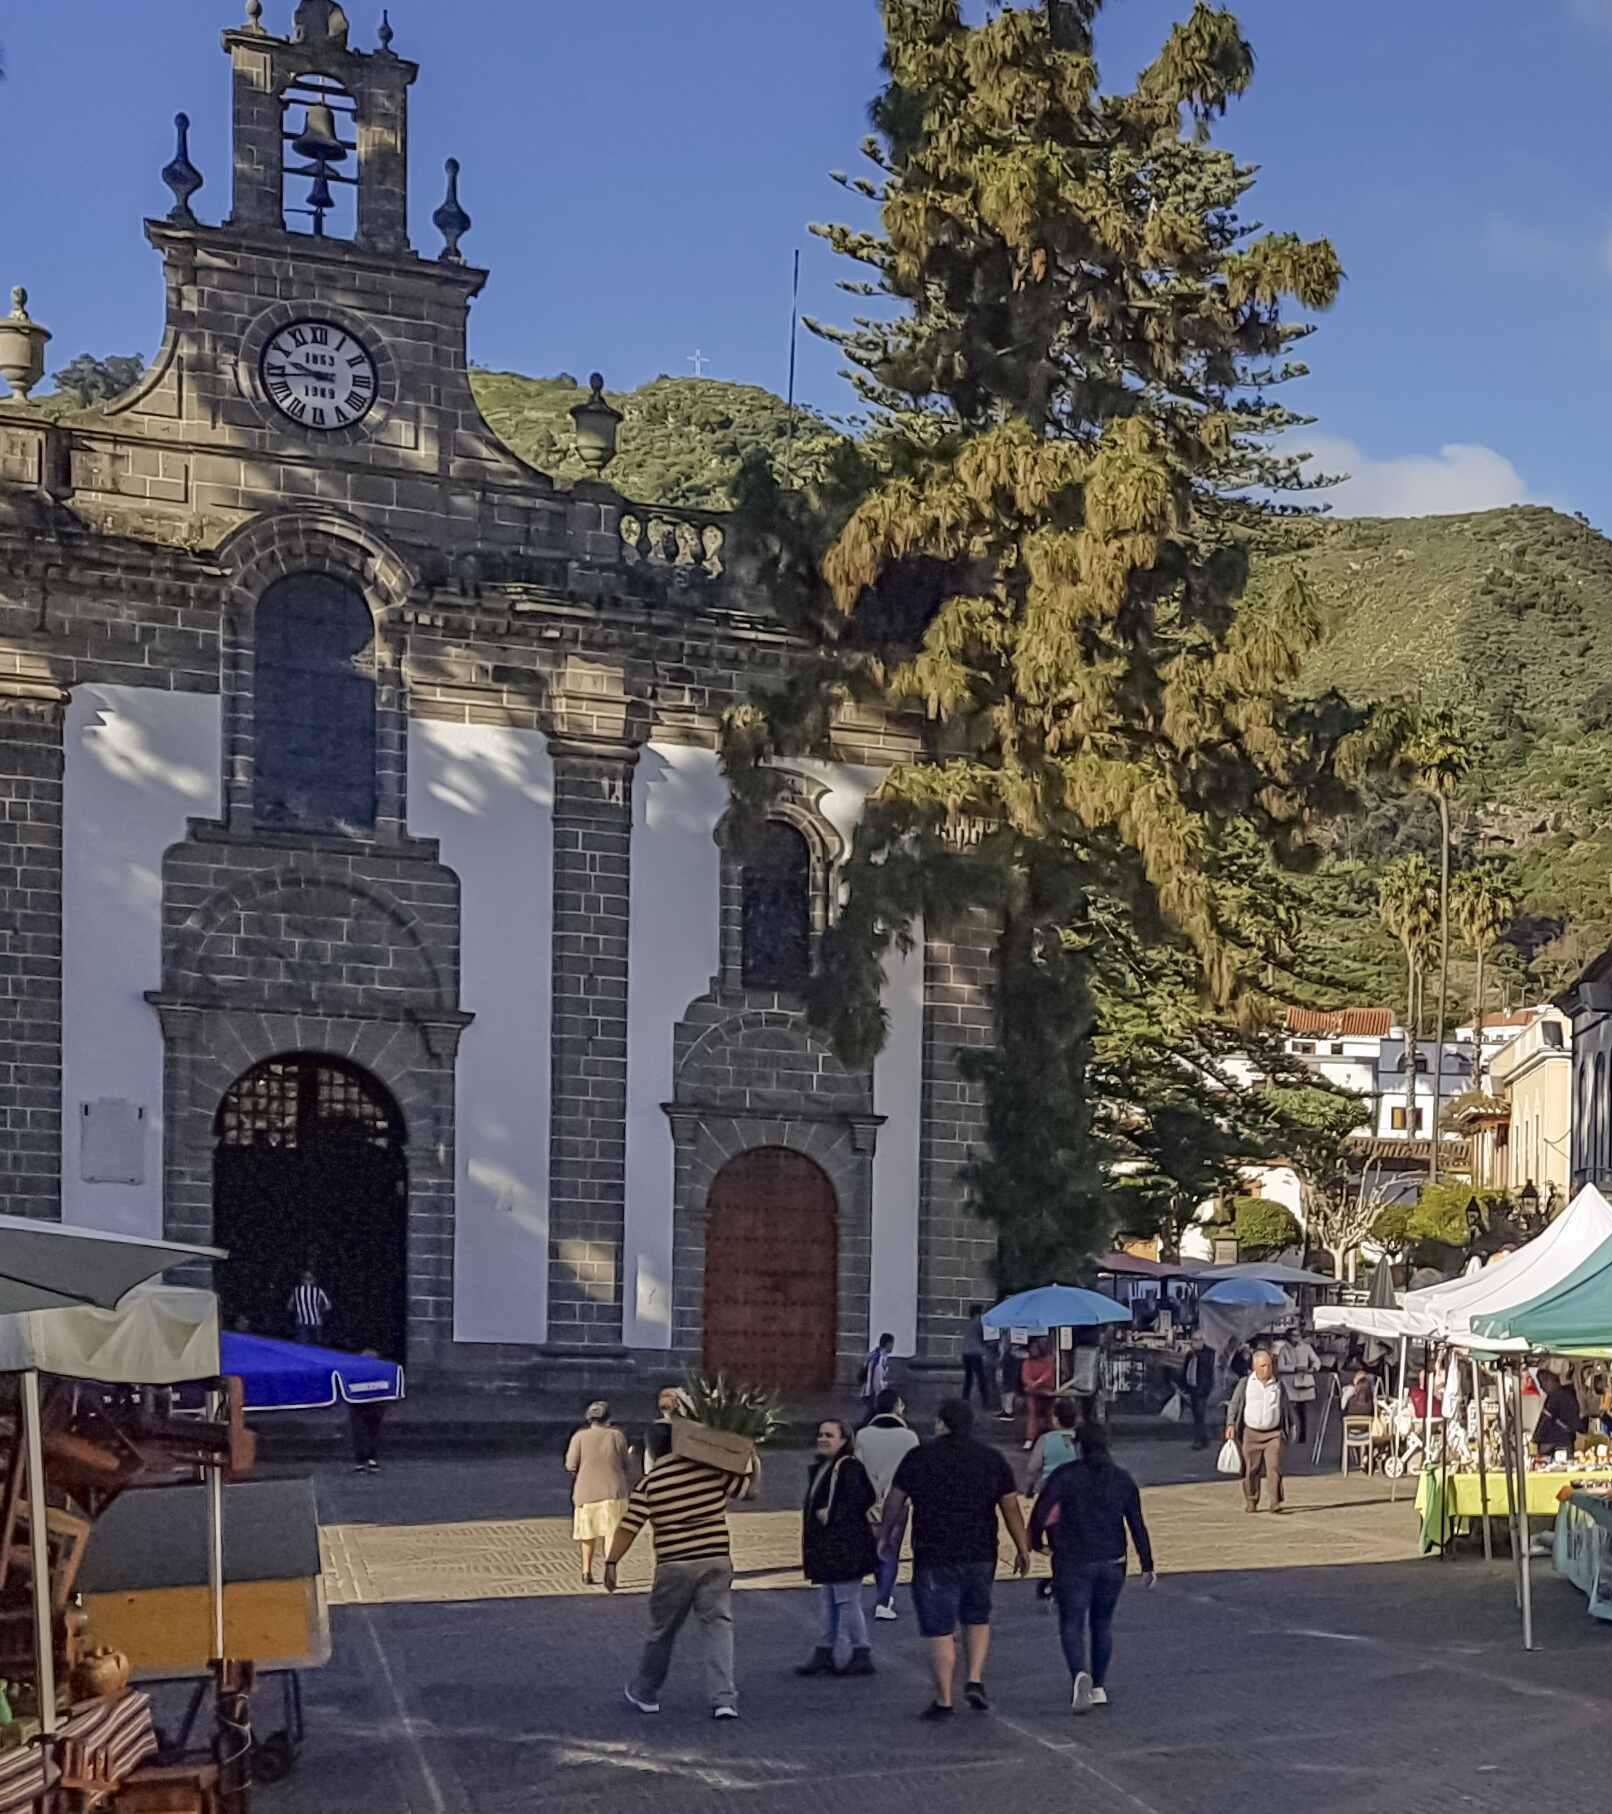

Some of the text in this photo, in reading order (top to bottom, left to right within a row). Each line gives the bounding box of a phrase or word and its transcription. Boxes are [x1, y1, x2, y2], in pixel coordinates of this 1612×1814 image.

[310, 326, 328, 346] XII
[271, 338, 293, 359] X
[346, 354, 366, 369] II
[352, 374, 372, 390] III
